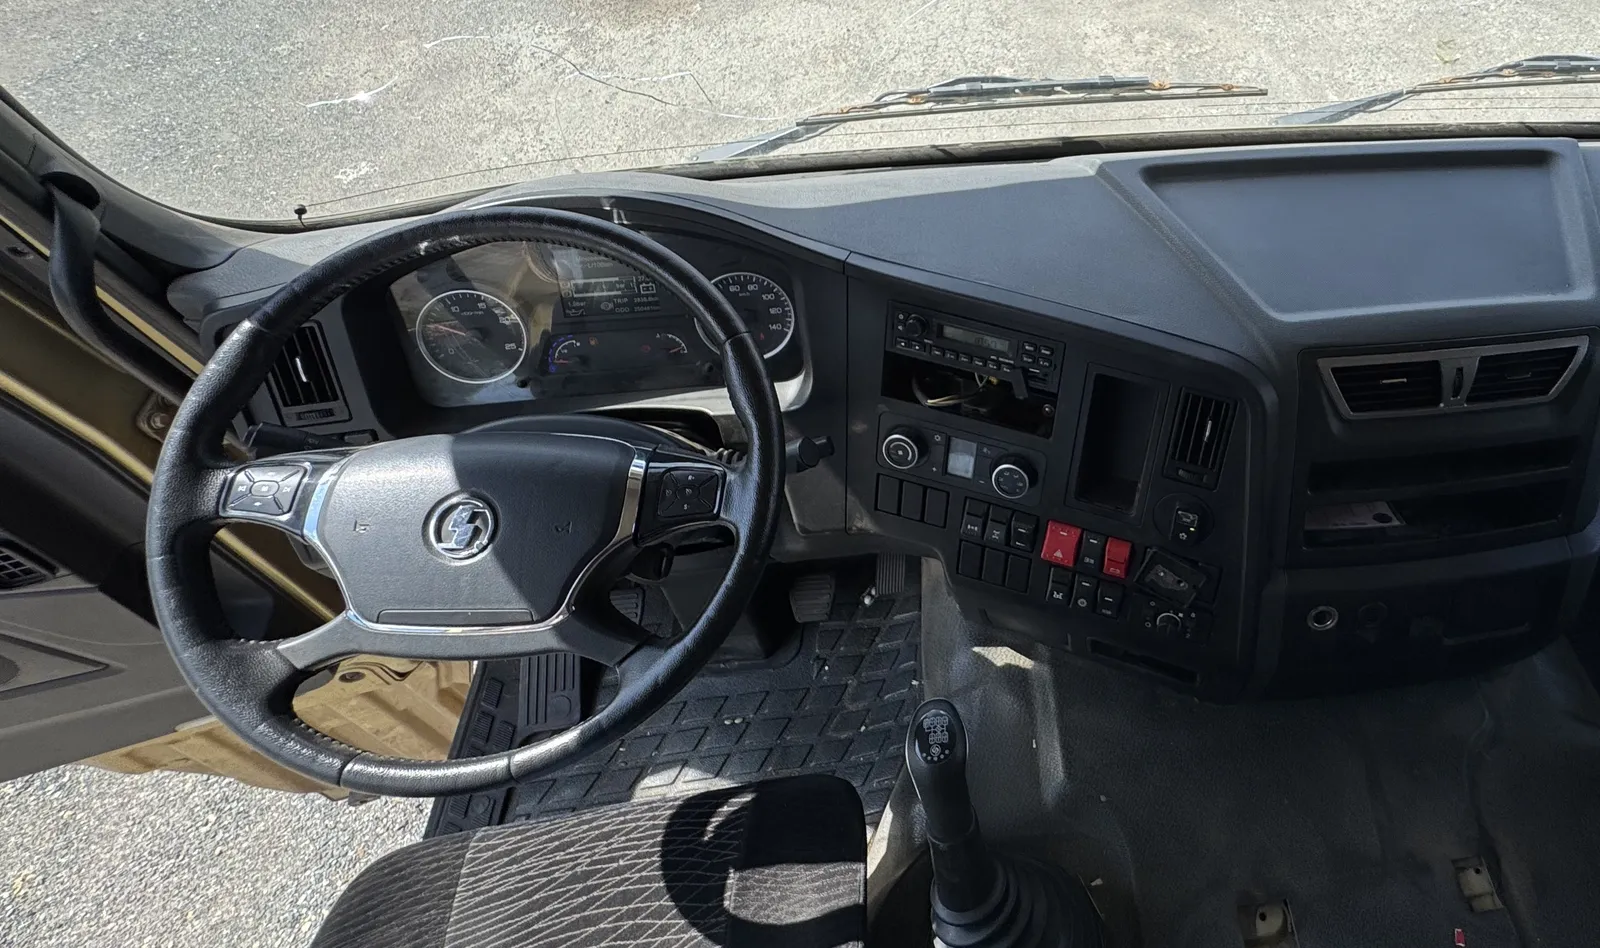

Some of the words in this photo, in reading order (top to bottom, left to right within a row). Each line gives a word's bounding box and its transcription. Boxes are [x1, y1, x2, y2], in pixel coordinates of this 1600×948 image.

[451, 305, 460, 313] 10
[499, 317, 511, 325] 20
[769, 323, 782, 331] 140
[504, 342, 517, 350] 25
